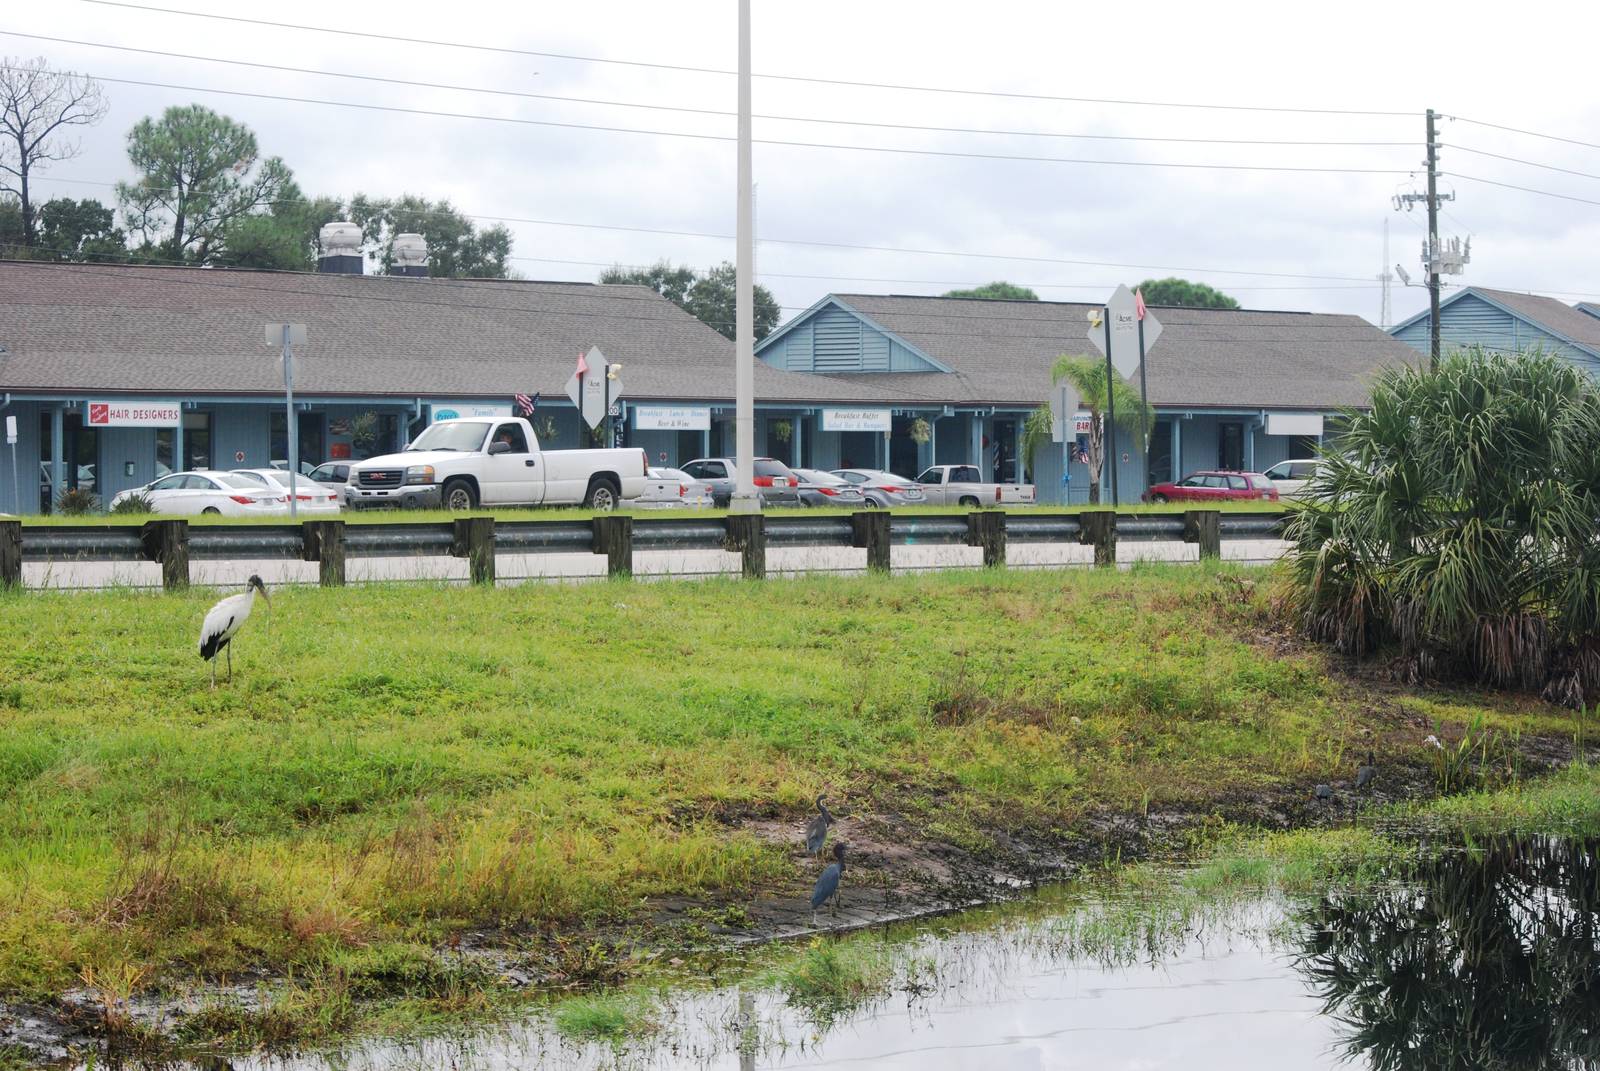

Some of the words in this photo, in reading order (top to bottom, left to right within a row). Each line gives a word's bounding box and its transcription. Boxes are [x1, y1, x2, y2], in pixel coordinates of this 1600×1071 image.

[110, 409, 130, 420] HAIR
[133, 409, 179, 421] DESIGNERS
[834, 411, 860, 420] Breakfast
